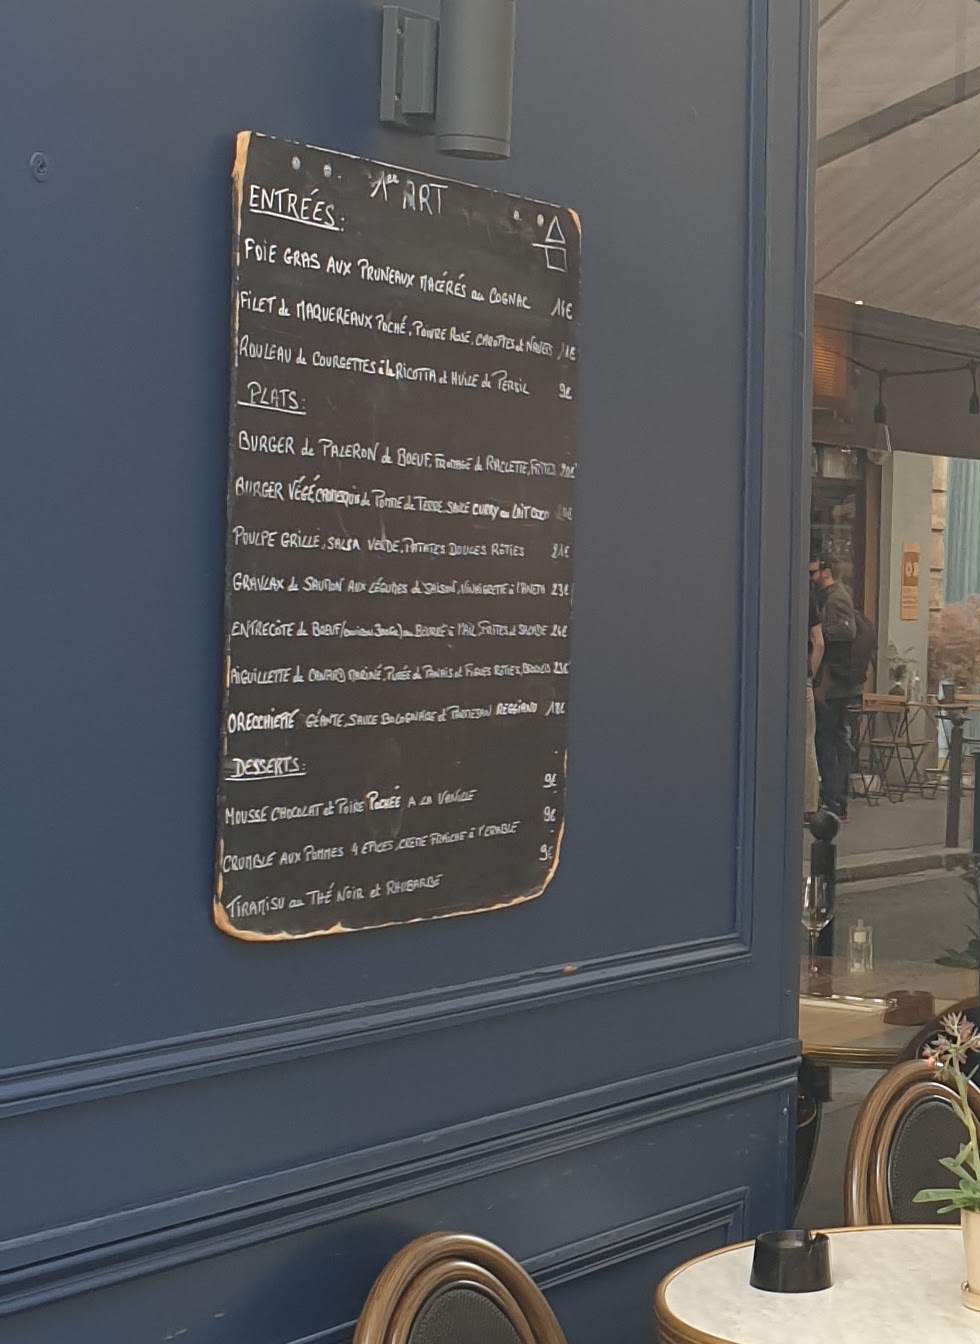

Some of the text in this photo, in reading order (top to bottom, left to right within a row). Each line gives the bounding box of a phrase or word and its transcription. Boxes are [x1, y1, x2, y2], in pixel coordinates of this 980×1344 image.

[402, 180, 449, 215] ART
[283, 247, 321, 269] GRAS
[326, 256, 352, 276] AUX
[357, 258, 415, 288] PRUNEAUX
[420, 270, 467, 298] MACÉRÉS
[489, 287, 531, 310] COGNAC
[278, 298, 290, 317] de
[296, 299, 372, 330] MAQUEREAUX
[239, 334, 292, 364] ROULEAU
[295, 347, 307, 365] de
[312, 351, 376, 375] COURGETTES
[395, 362, 437, 383] RICOTTA
[491, 370, 530, 395] PERSIL
[238, 430, 295, 455] BURGER
[301, 437, 315, 456] de
[318, 438, 380, 462] PALERON
[235, 476, 284, 501] BURGER
[232, 525, 278, 548] POULPE
[327, 536, 361, 551] SALSA
[448, 542, 487, 556] DOUCES
[232, 572, 284, 592] GRAVLAX
[302, 576, 345, 593] SAUMON
[347, 580, 366, 594] AUX
[224, 805, 268, 825] MOUSSE
[271, 803, 324, 822] CHOCOLAT
[222, 851, 277, 873] CRUMBLE
[279, 852, 302, 866] AUX
[302, 844, 344, 862] POMMES
[226, 894, 285, 918] TIRAMISU
[306, 882, 335, 906] THÉ
[386, 874, 444, 895] RHUBARBE
